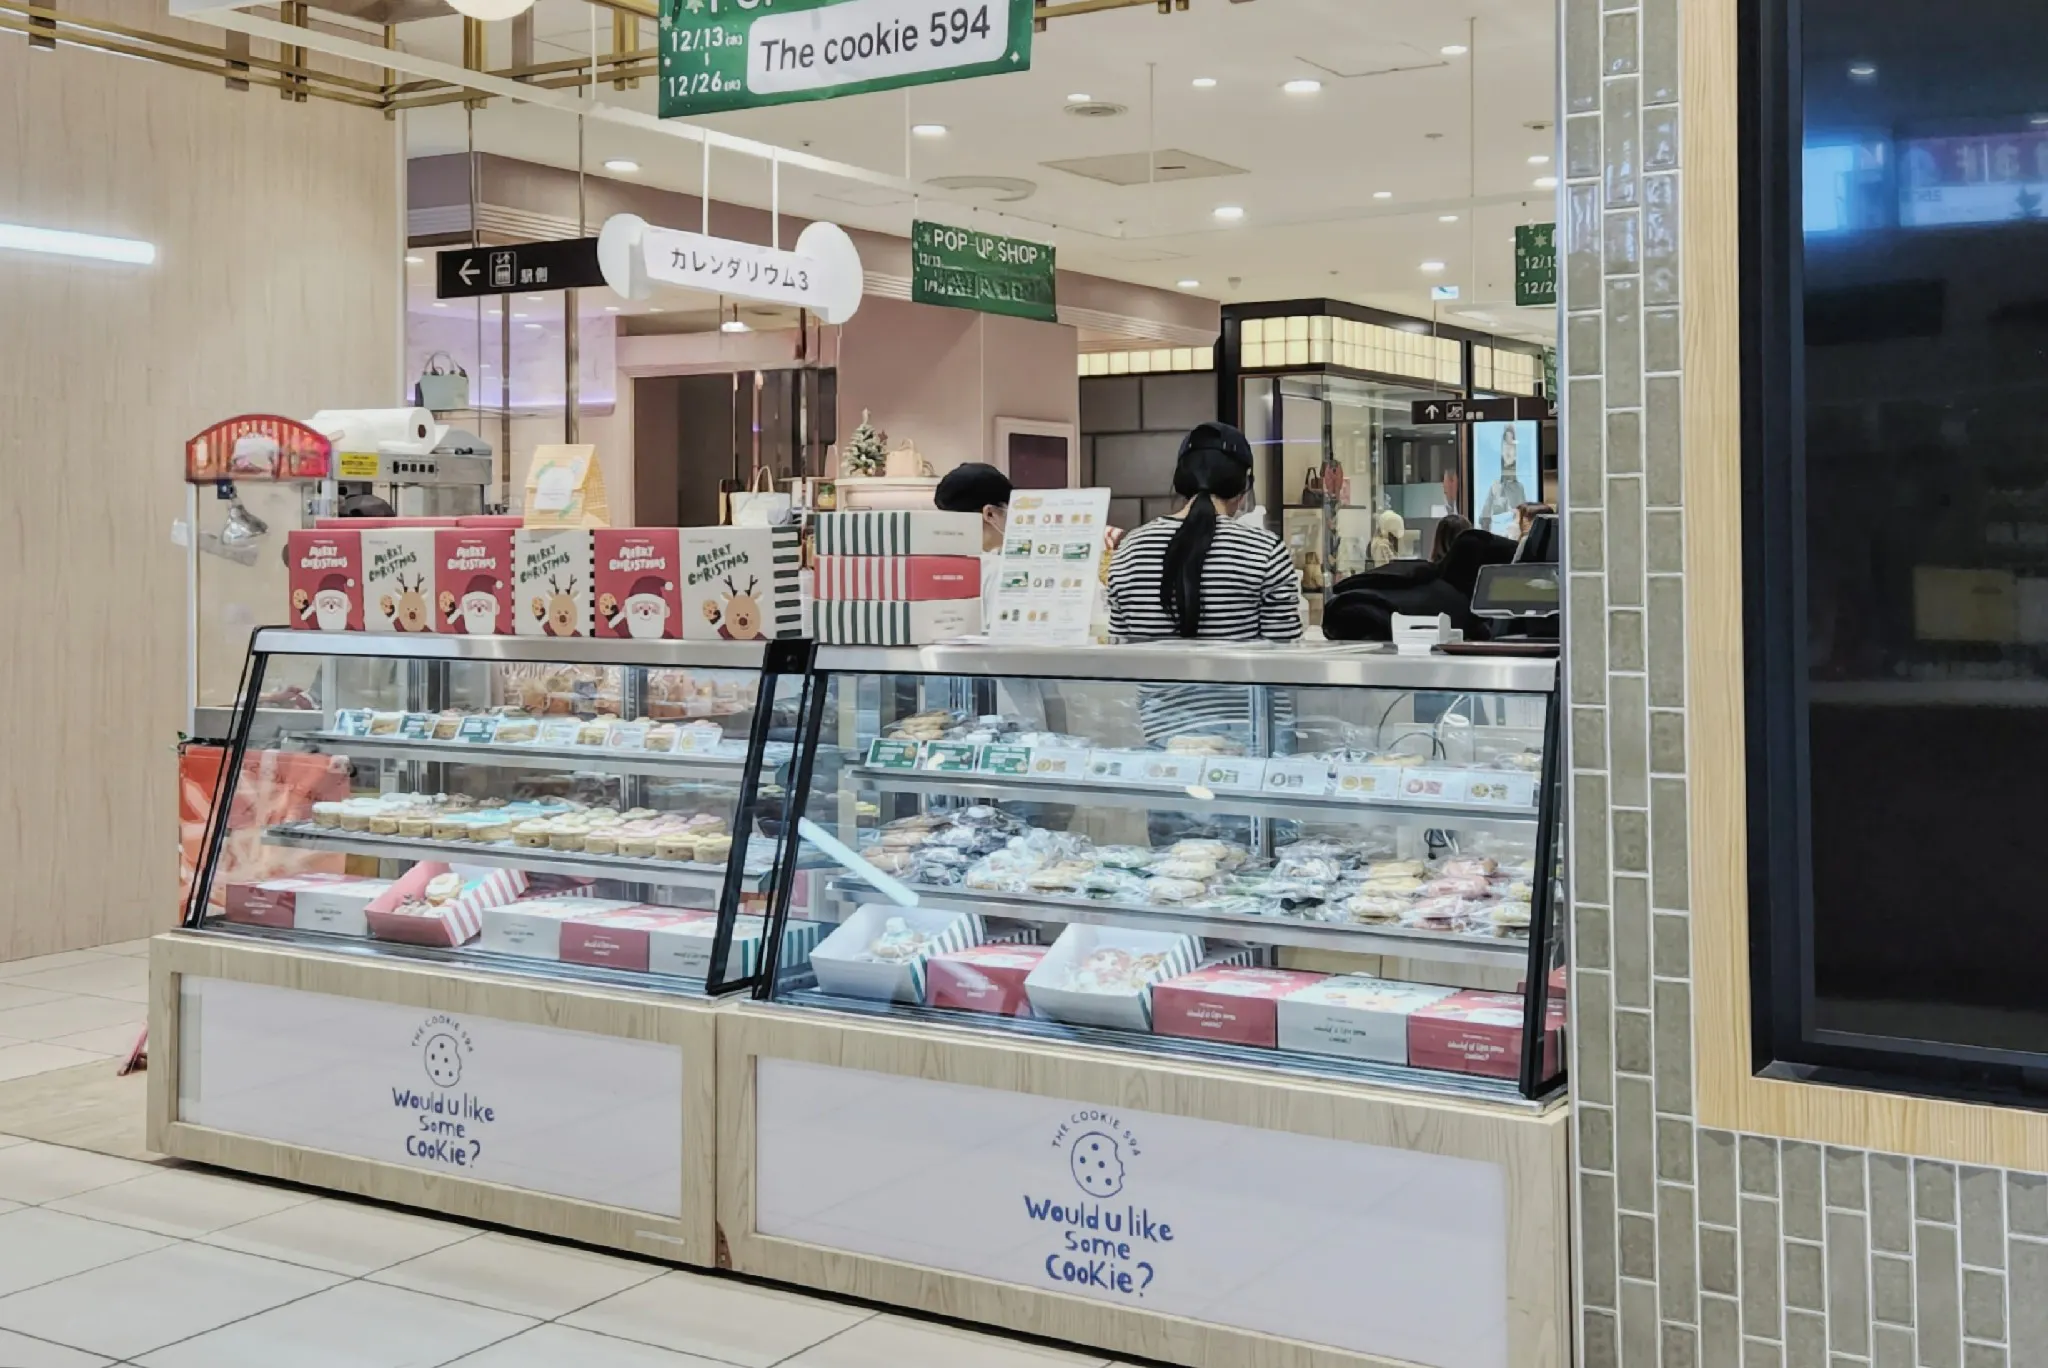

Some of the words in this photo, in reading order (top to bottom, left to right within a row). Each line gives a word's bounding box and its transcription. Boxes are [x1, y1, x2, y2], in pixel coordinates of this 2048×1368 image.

[759, 38, 815, 72] The
[823, 18, 919, 65] cookie
[929, 4, 991, 48] 594
[933, 228, 994, 259] POP-UP
[997, 241, 1038, 265] SHOP
[671, 248, 809, 291] カレンダリウム3
[425, 1014, 460, 1031] COOKIE
[391, 1086, 444, 1114] Would
[463, 1092, 495, 1123] like
[1051, 1123, 1070, 1148] THE
[1070, 1110, 1121, 1130] COOKIE
[1023, 1194, 1100, 1231] Would
[1128, 1204, 1175, 1243] like
